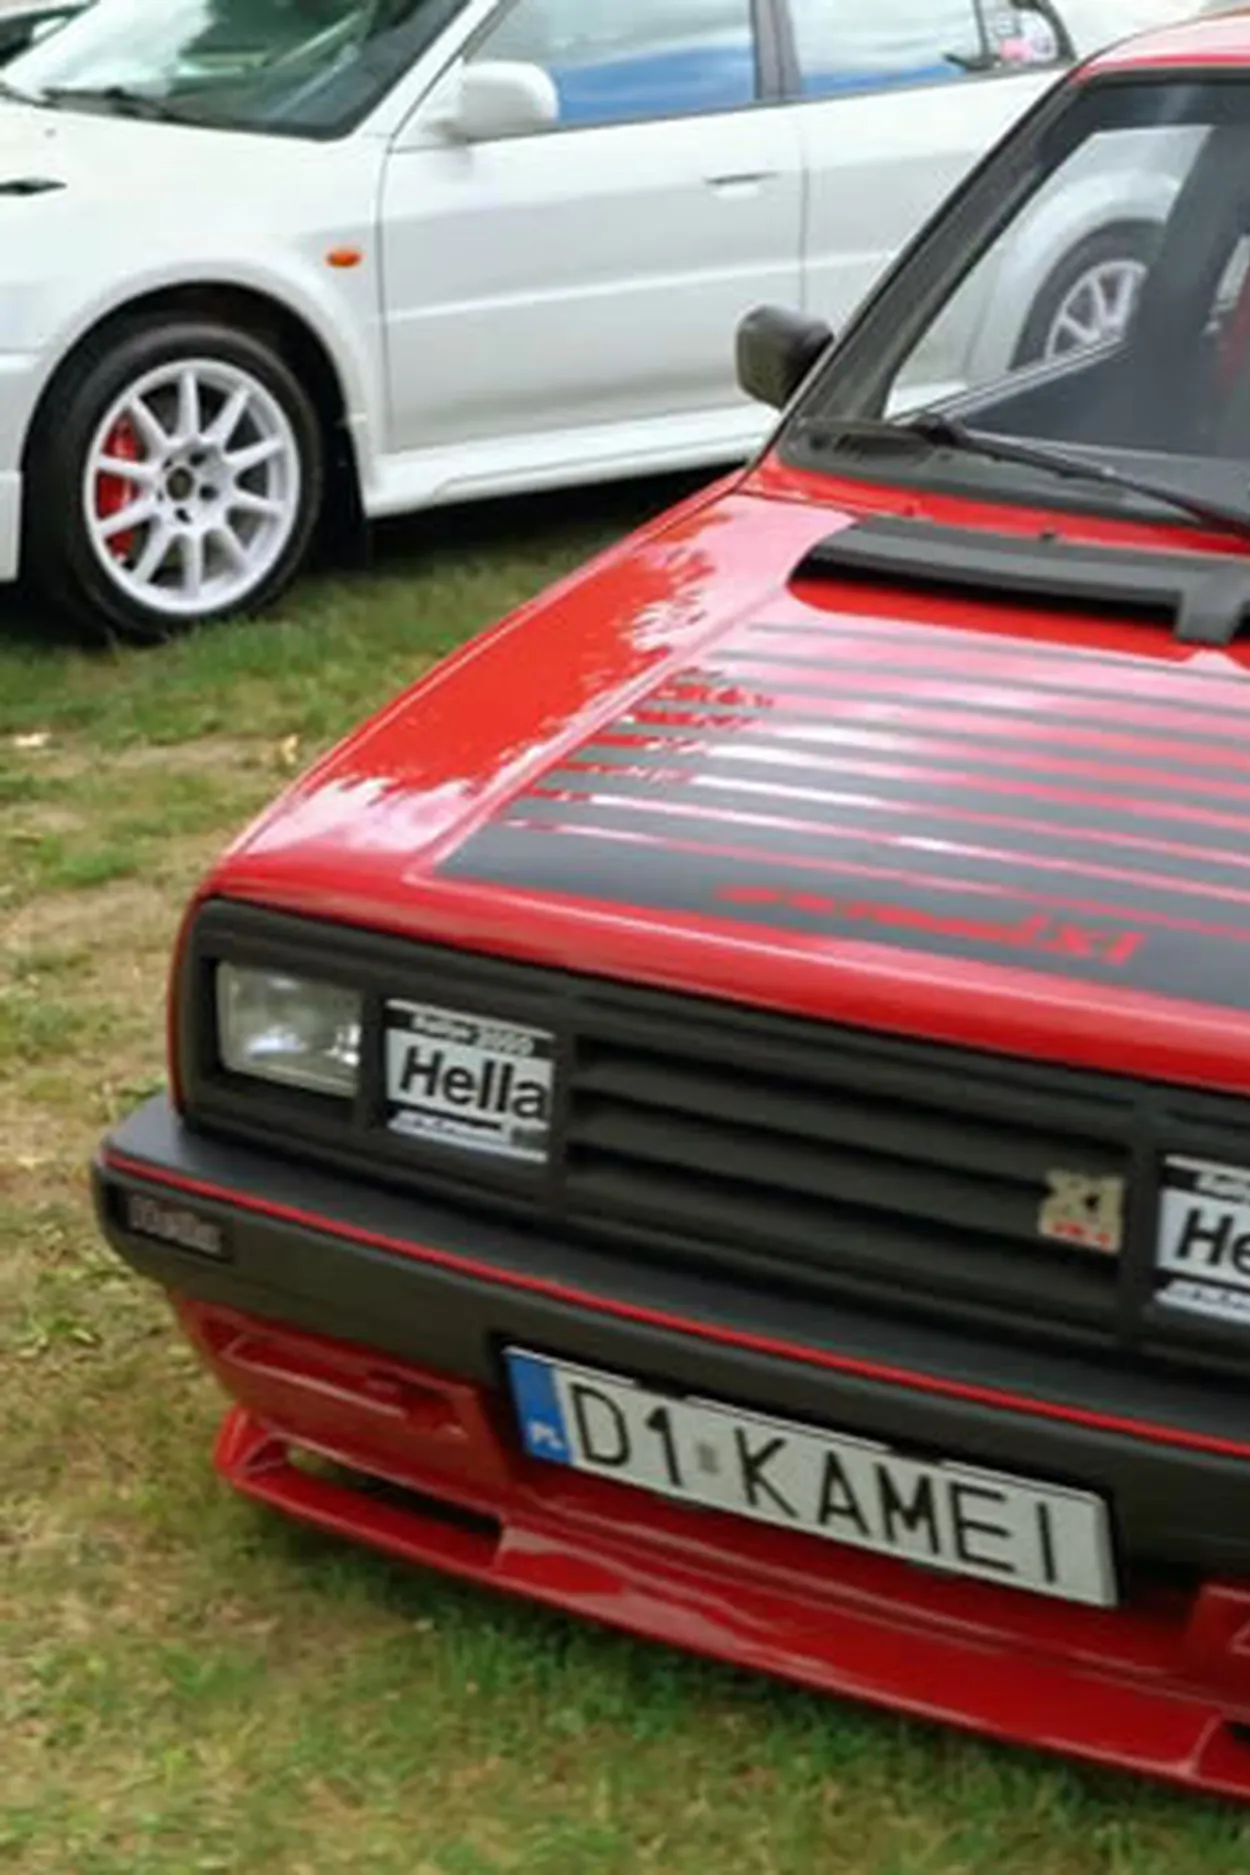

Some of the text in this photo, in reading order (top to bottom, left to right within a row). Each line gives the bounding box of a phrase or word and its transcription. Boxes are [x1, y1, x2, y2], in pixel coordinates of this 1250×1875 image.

[398, 1044, 549, 1120] Hella
[569, 1382, 1057, 1585] D1 KAMEI
